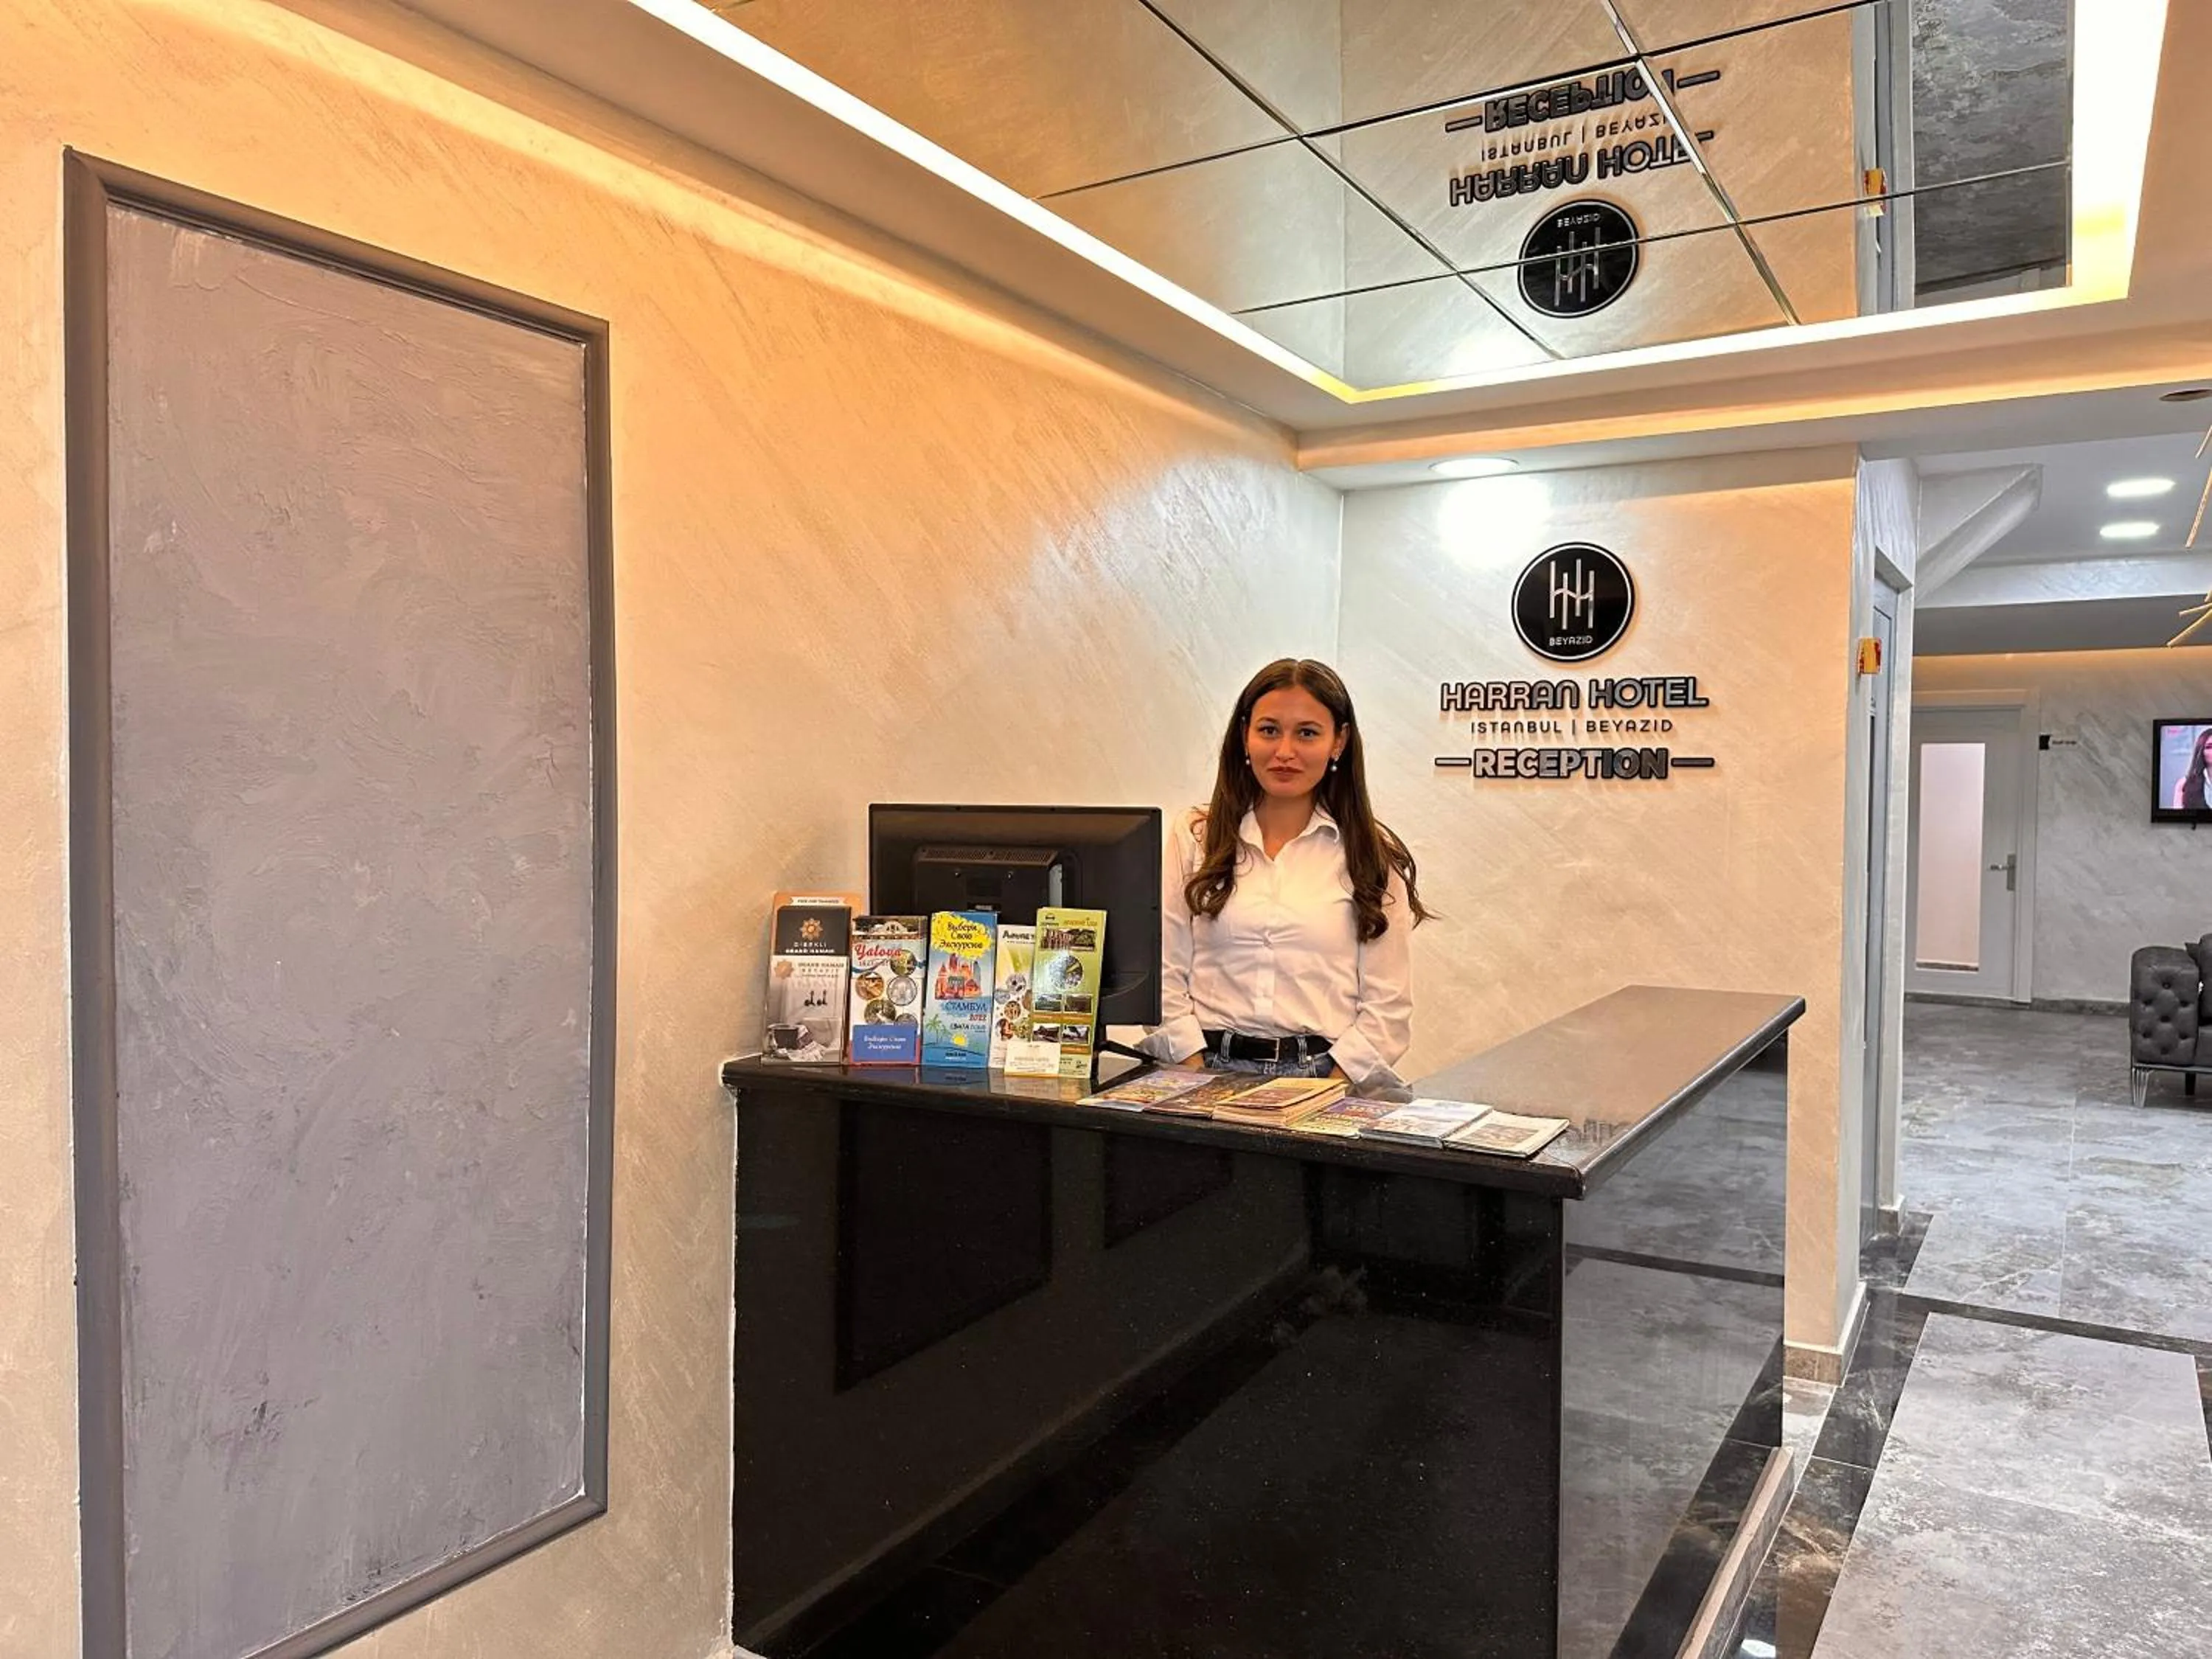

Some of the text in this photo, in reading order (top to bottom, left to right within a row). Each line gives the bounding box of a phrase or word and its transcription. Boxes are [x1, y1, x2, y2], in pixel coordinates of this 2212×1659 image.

[1549, 635, 1593, 647] BEYAZID
[1441, 677, 1710, 712] HARRAN HOTEL
[1471, 719, 1674, 734] ISTANBUL BEYAZID
[1474, 748, 1669, 779] RECEPTION
[855, 943, 902, 960] Yalova
[945, 1001, 987, 1012] СТАМБУЛ
